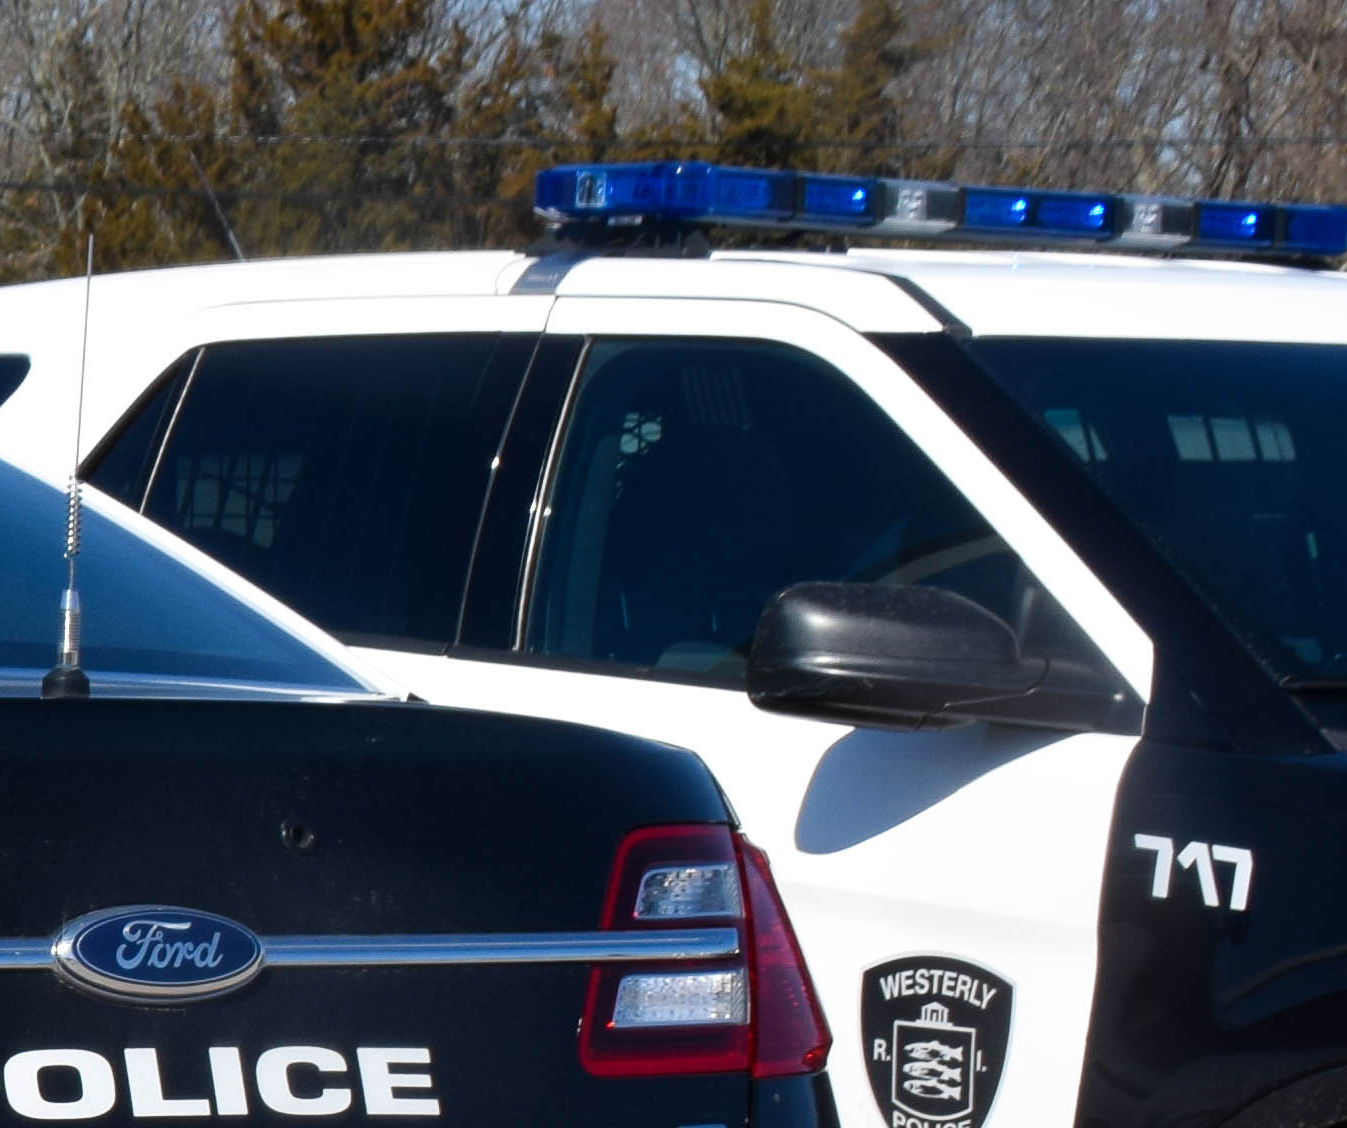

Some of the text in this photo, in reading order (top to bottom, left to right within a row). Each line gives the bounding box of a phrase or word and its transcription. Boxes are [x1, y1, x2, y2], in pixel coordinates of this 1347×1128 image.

[1134, 833, 1253, 912] 717
[116, 919, 223, 970] Ford
[879, 968, 997, 1010] WESTERLY
